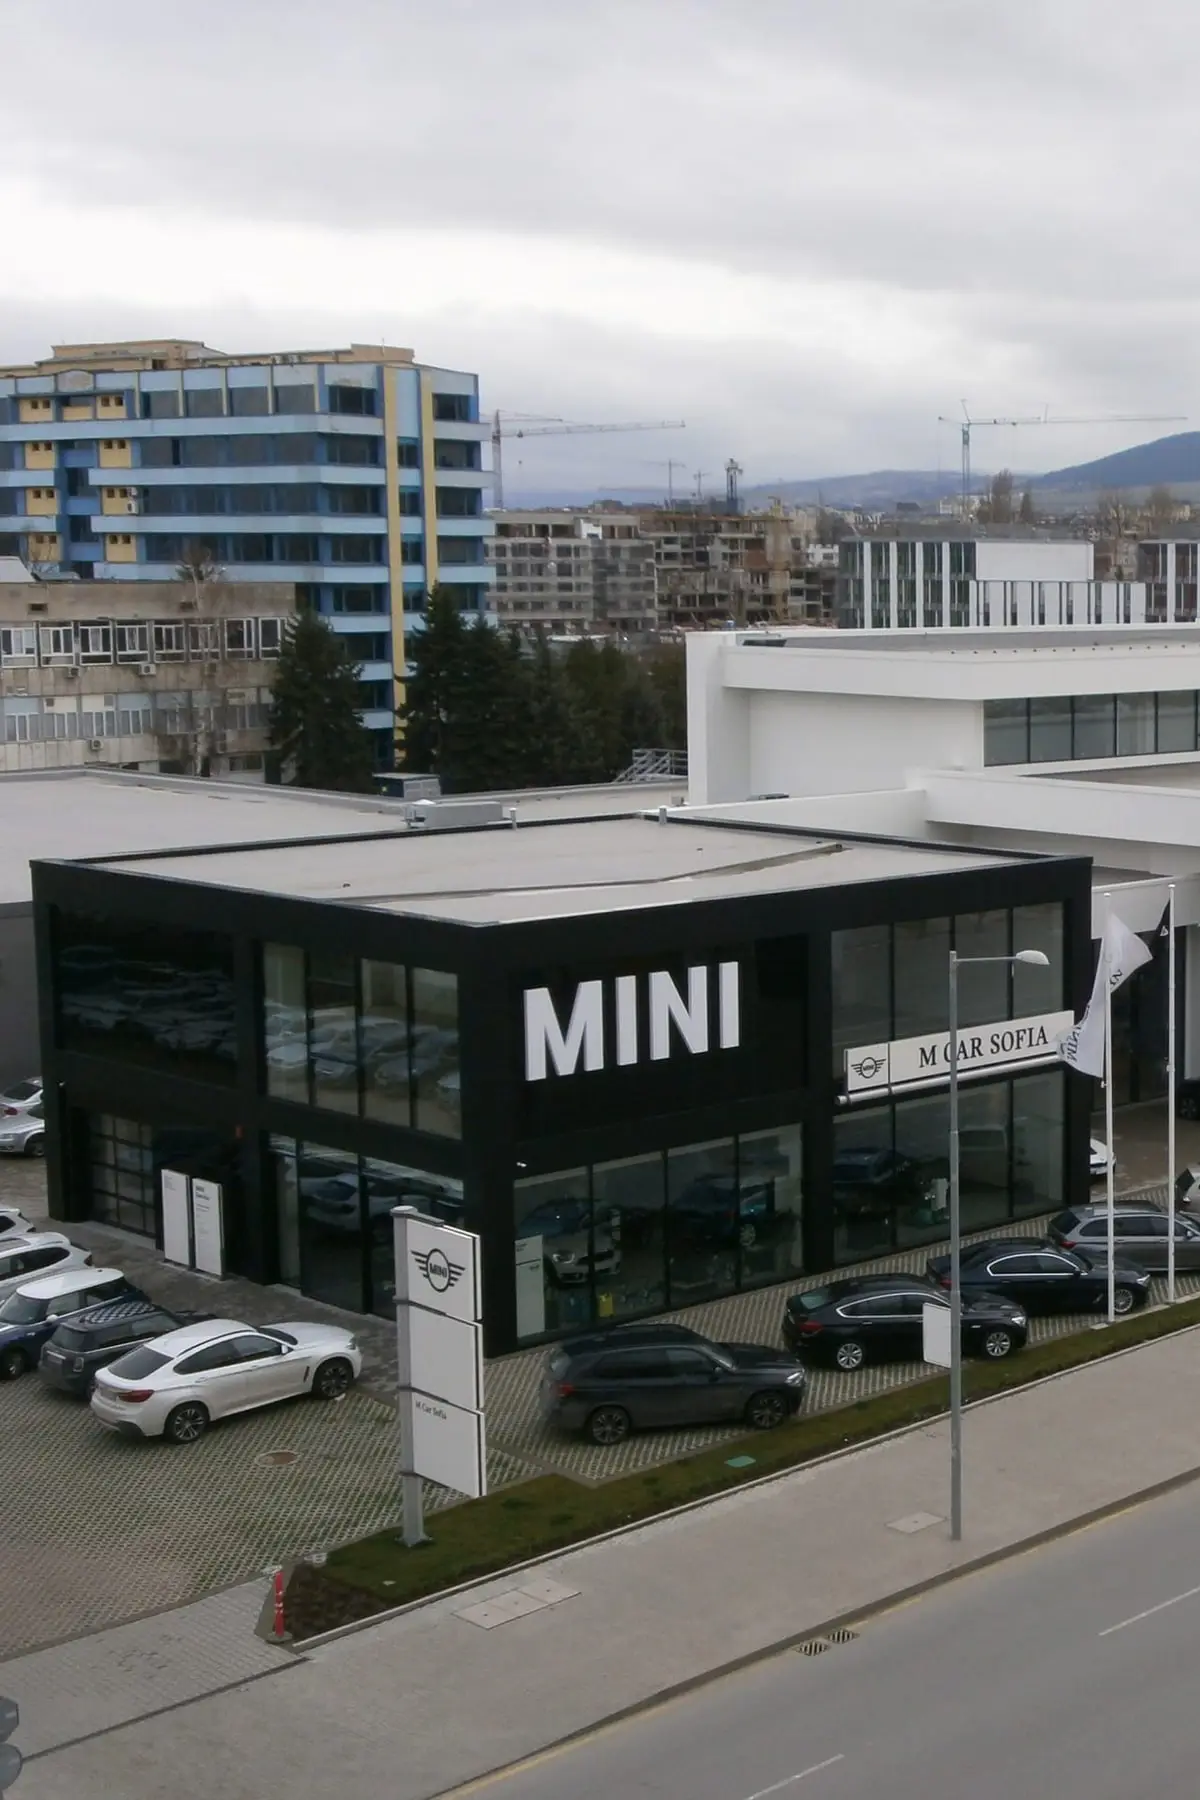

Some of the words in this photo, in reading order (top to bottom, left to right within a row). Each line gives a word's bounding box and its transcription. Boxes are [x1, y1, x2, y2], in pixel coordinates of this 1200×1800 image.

[523, 961, 740, 1081] MINI
[919, 1047, 937, 1068] M
[990, 1025, 1049, 1054] SOFIA
